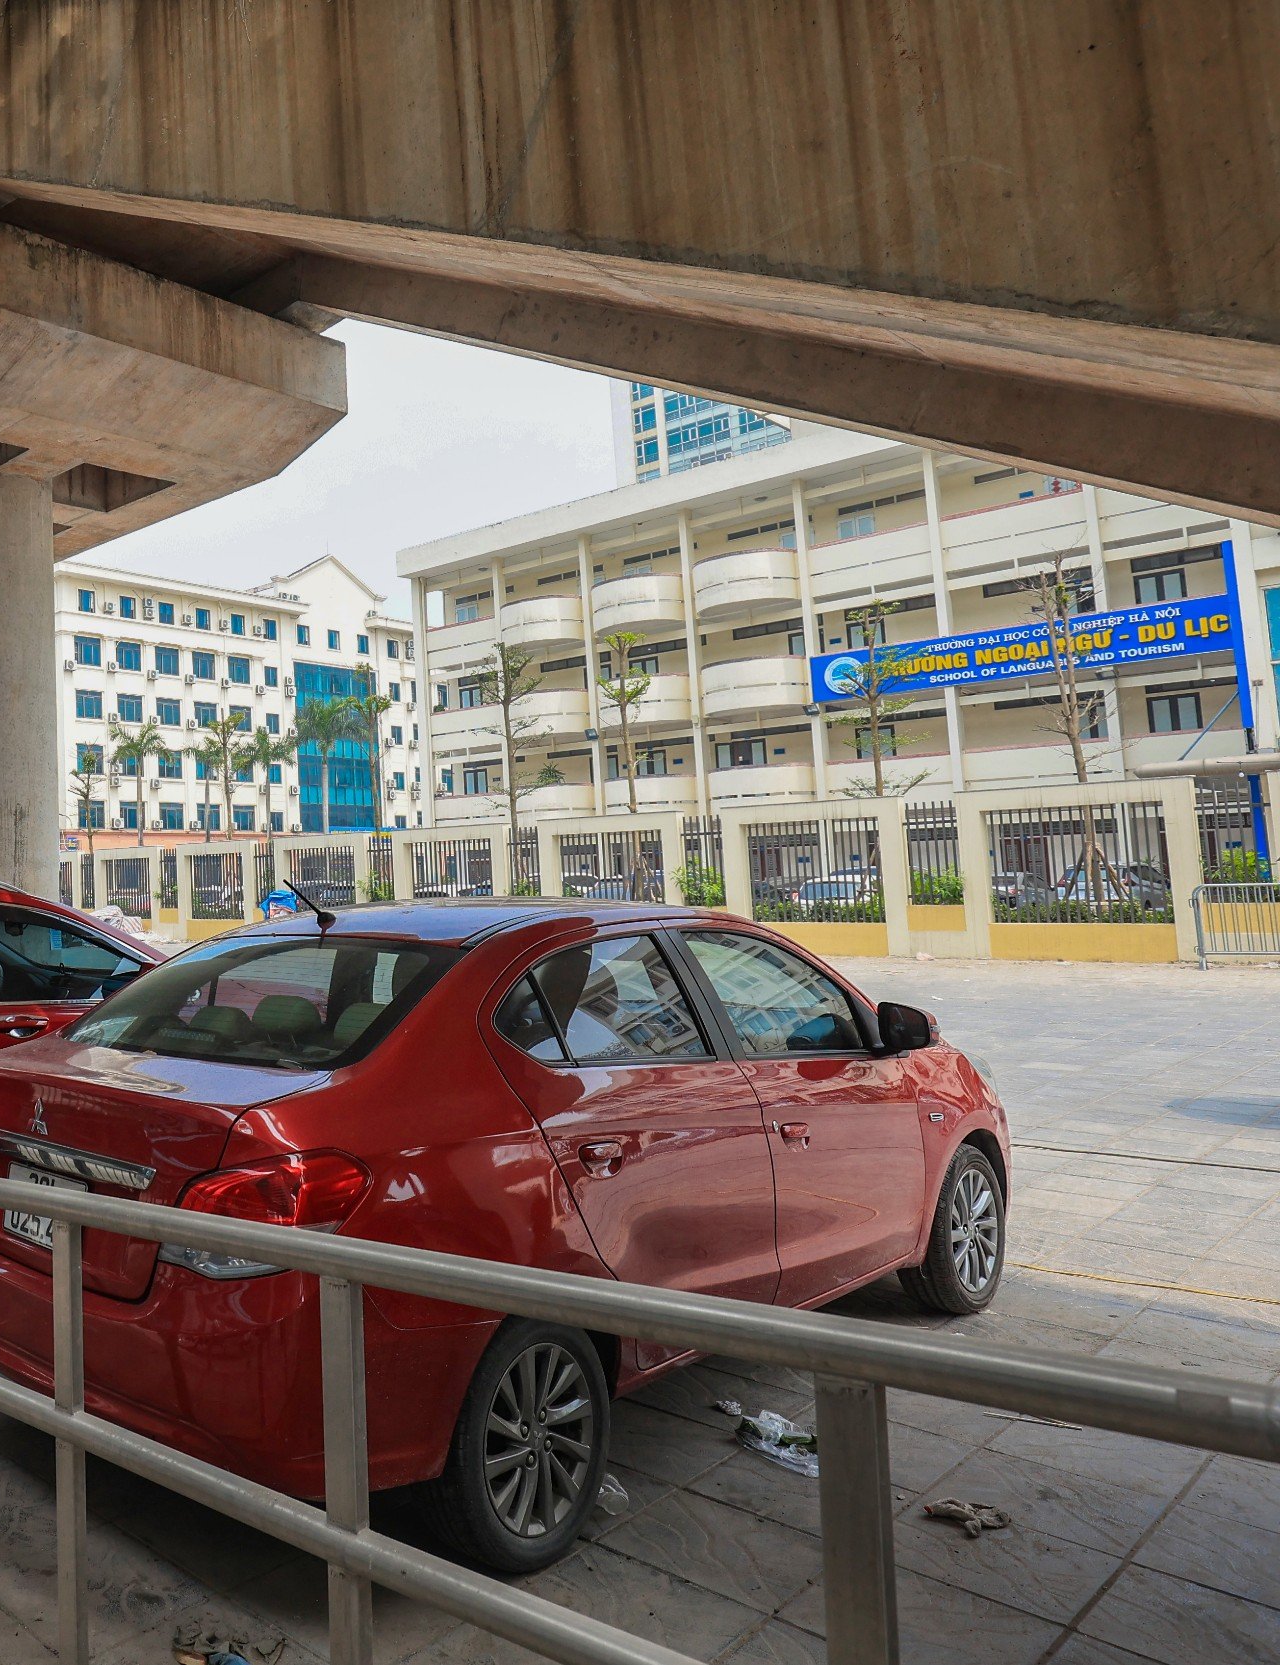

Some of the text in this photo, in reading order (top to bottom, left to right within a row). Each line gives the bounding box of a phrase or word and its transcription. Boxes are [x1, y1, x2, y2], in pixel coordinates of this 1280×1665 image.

[883, 652, 968, 678] RƯỜNG
[975, 640, 1049, 666] NGOẠI
[1138, 621, 1175, 643] DU
[1185, 614, 1229, 637] LỊC
[926, 607, 1182, 653] TRƯỜNG ĐẠI HỌC CÔG NGHIỆP HÀ NỘI
[929, 670, 978, 684] SCHOOL
[981, 667, 997, 677] OF
[1085, 652, 1115, 664] AND
[1119, 642, 1185, 658] TOURISM
